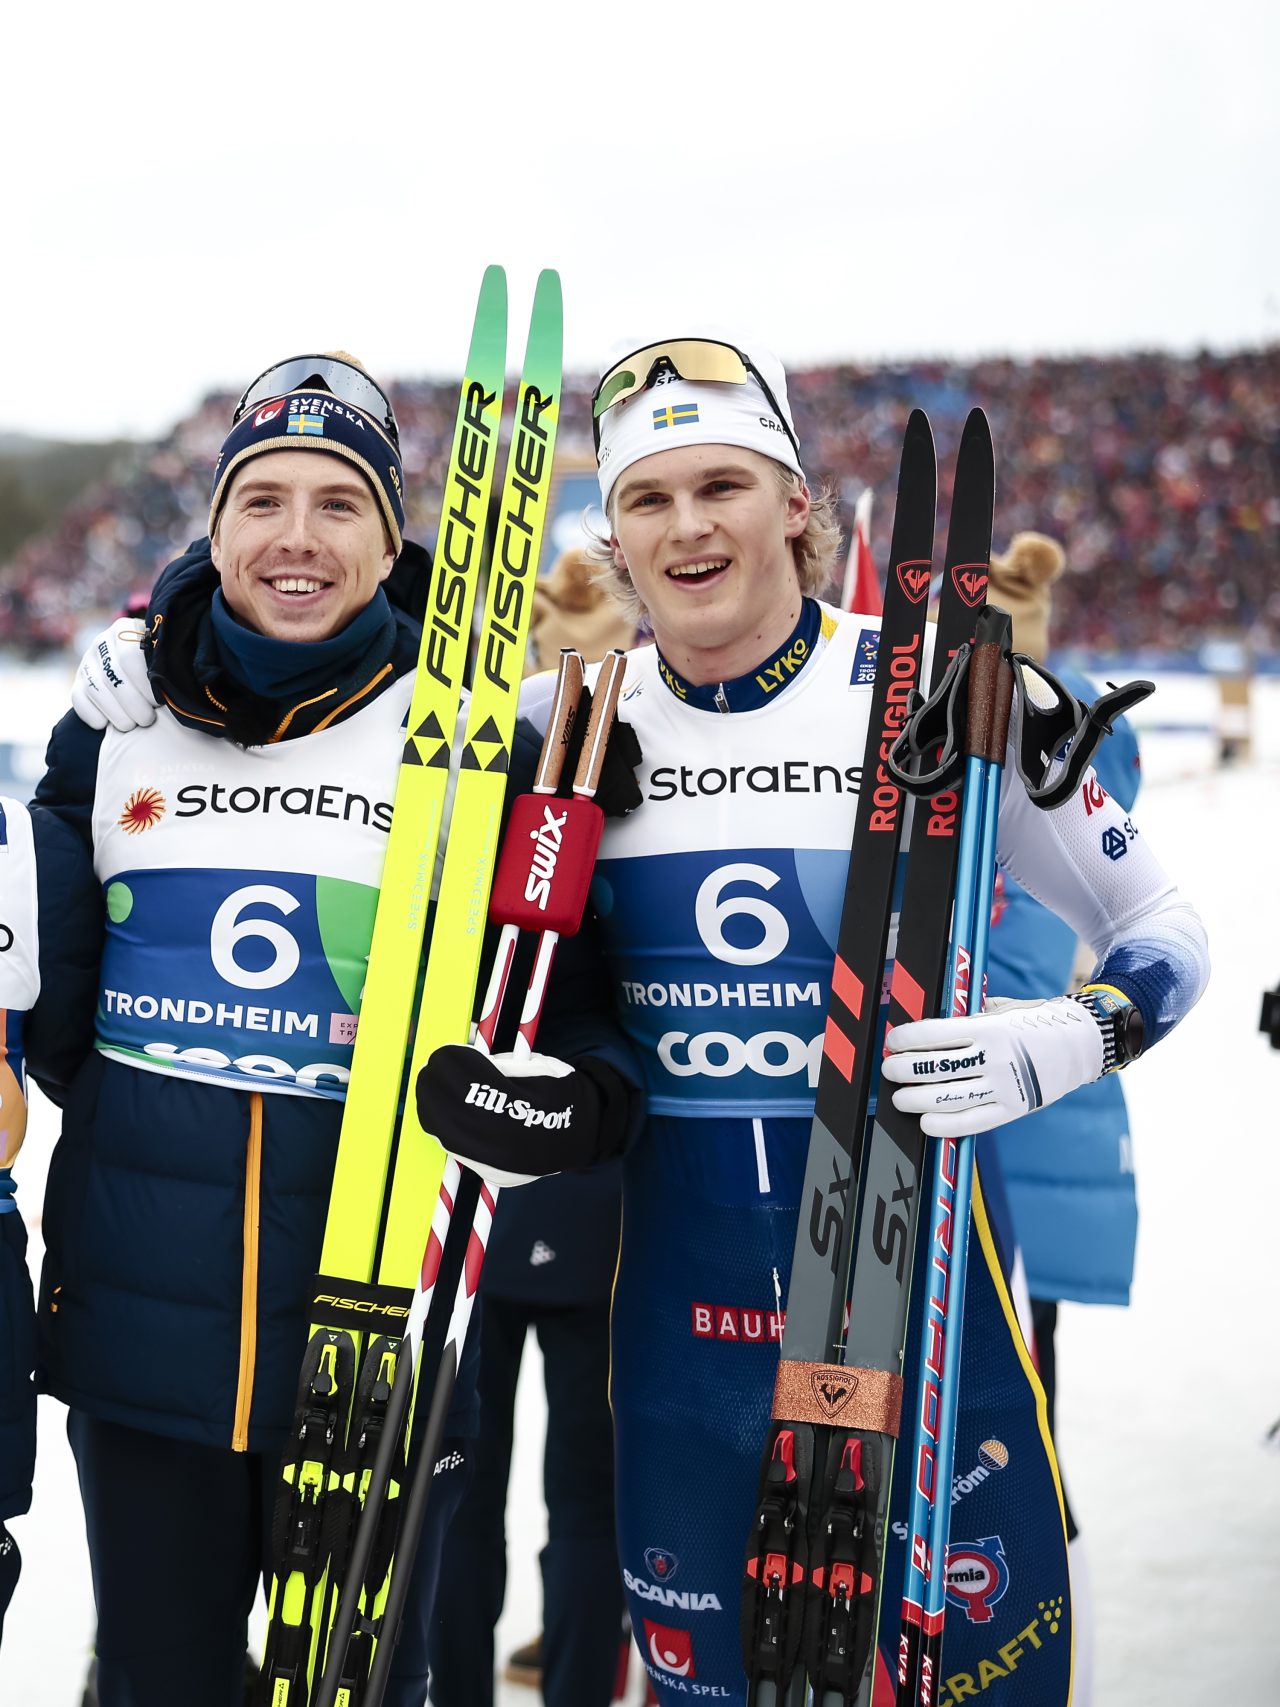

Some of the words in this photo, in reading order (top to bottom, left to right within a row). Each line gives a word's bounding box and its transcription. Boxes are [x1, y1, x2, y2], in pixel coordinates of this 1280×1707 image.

[288, 405, 329, 418] SPEL
[290, 397, 365, 431] SVENSKA
[427, 380, 497, 689] FISCHER
[484, 384, 553, 693] FISCHER
[755, 638, 810, 694] LYKO
[210, 884, 301, 989] 6
[694, 862, 790, 966] 6
[104, 988, 320, 1038] TRONDHEIM
[621, 981, 821, 1007] TRONDHEIM
[816, 1374, 853, 1386] ROSSIGNOL
[623, 1568, 723, 1611] SCANIA
[692, 1684, 731, 1697] SPEL
